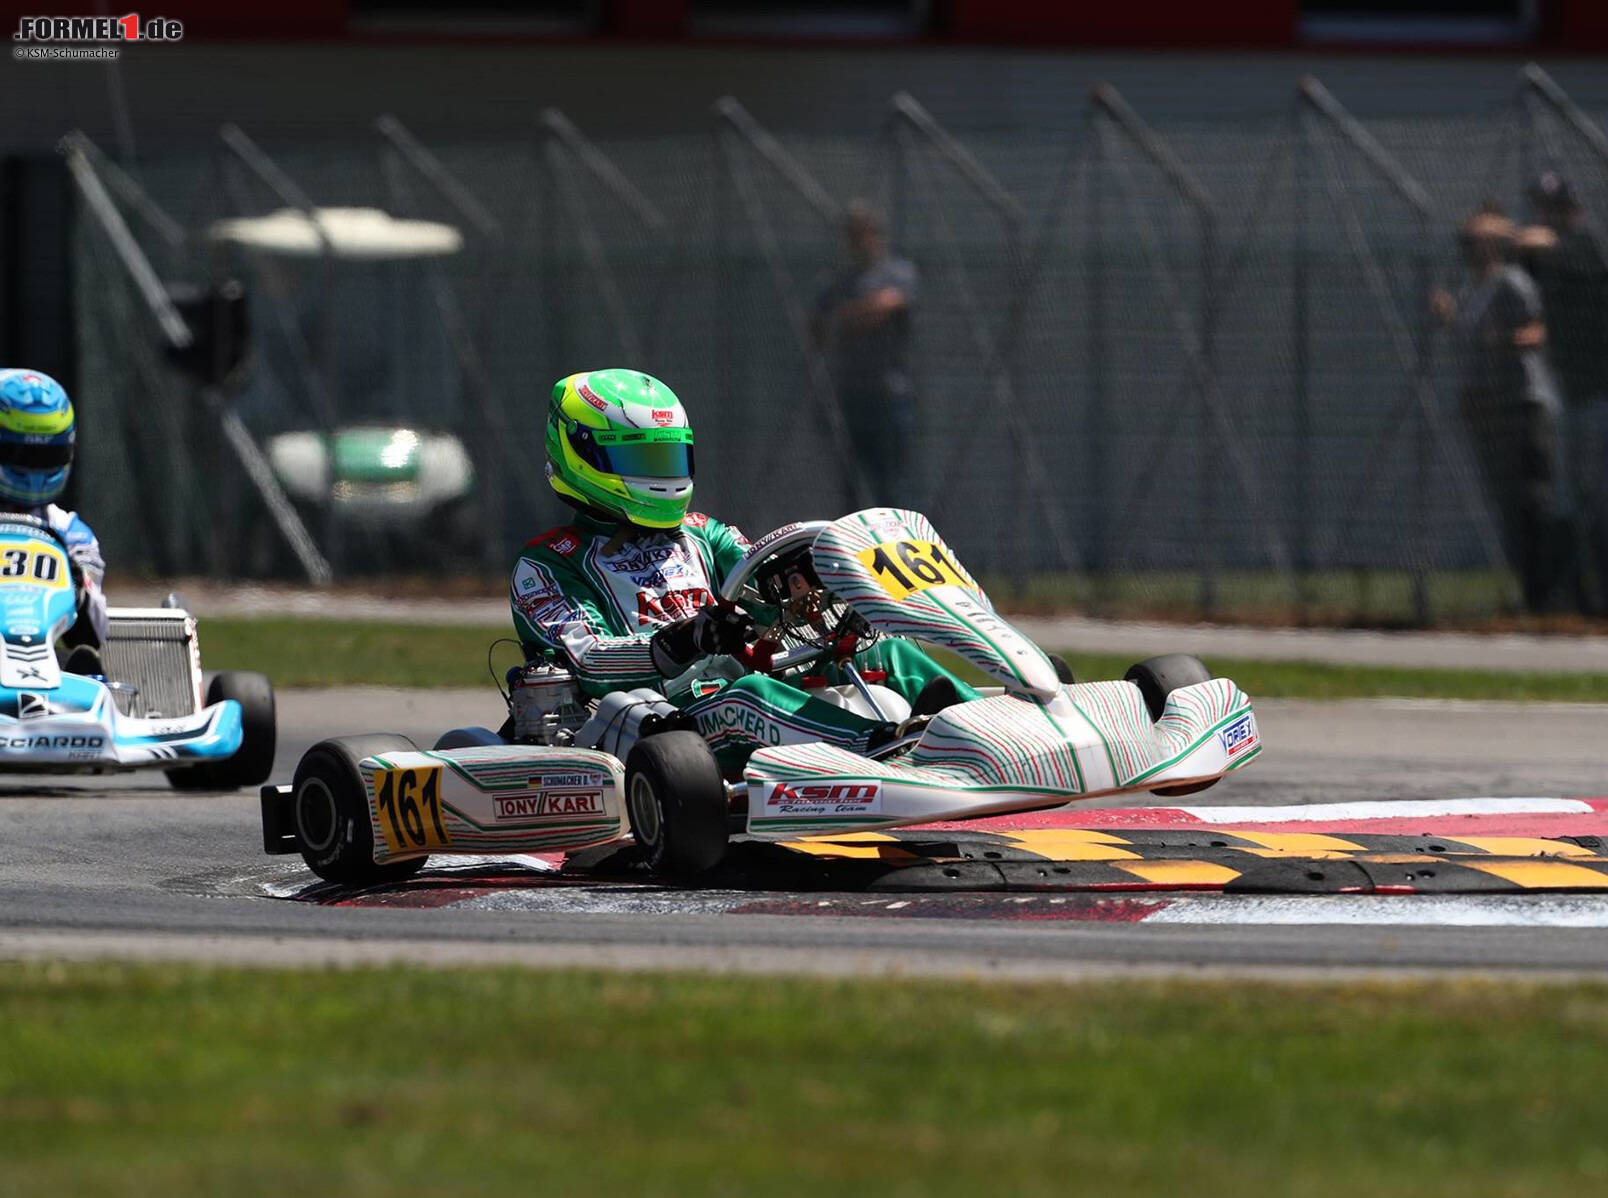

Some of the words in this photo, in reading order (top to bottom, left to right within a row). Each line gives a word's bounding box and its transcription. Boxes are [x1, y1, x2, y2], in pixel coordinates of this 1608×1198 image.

[2, 549, 59, 581] 30
[872, 541, 971, 592] 161
[379, 767, 448, 848] 161
